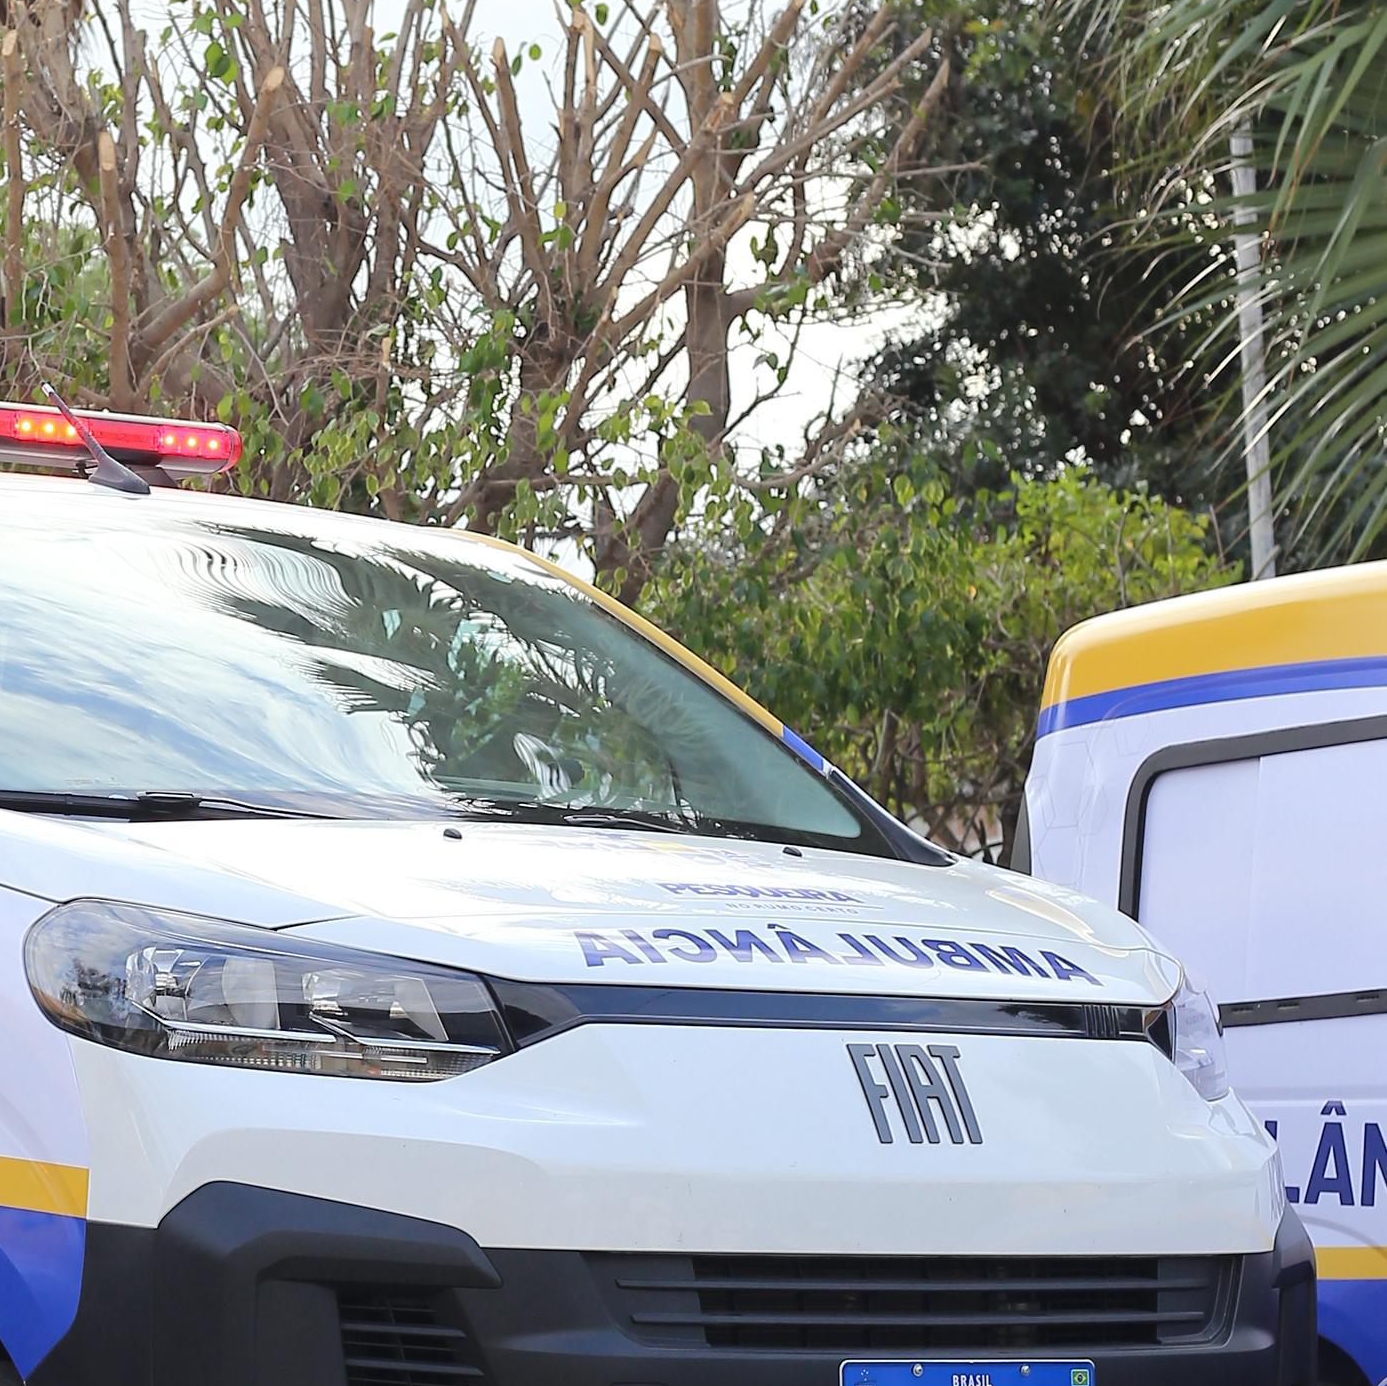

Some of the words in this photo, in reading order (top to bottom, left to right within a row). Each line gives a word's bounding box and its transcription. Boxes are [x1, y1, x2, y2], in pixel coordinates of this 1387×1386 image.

[657, 882, 865, 904] PESQUEIRA
[846, 1044, 983, 1144] FIAT
[1264, 1100, 1387, 1206] ÂN
